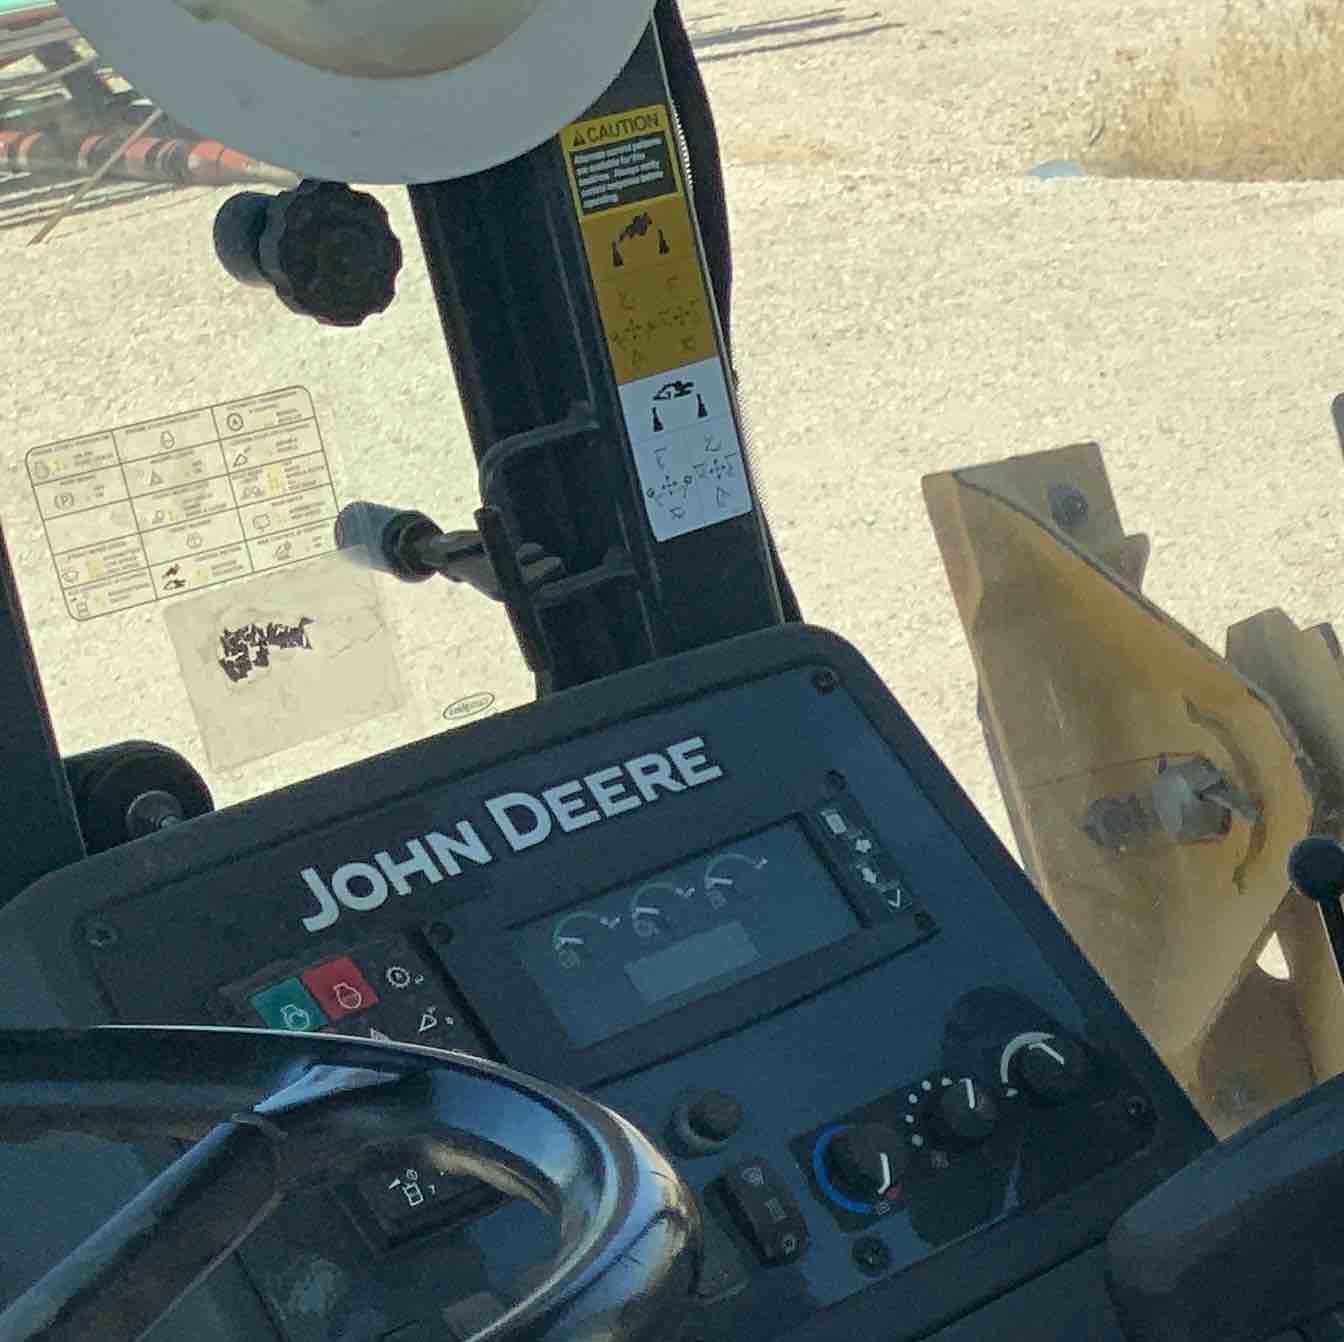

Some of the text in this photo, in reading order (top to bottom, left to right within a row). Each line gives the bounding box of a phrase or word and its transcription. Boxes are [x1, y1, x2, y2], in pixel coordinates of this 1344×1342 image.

[587, 112, 660, 140] CAUTION
[299, 735, 723, 933] JOHN DEERE
